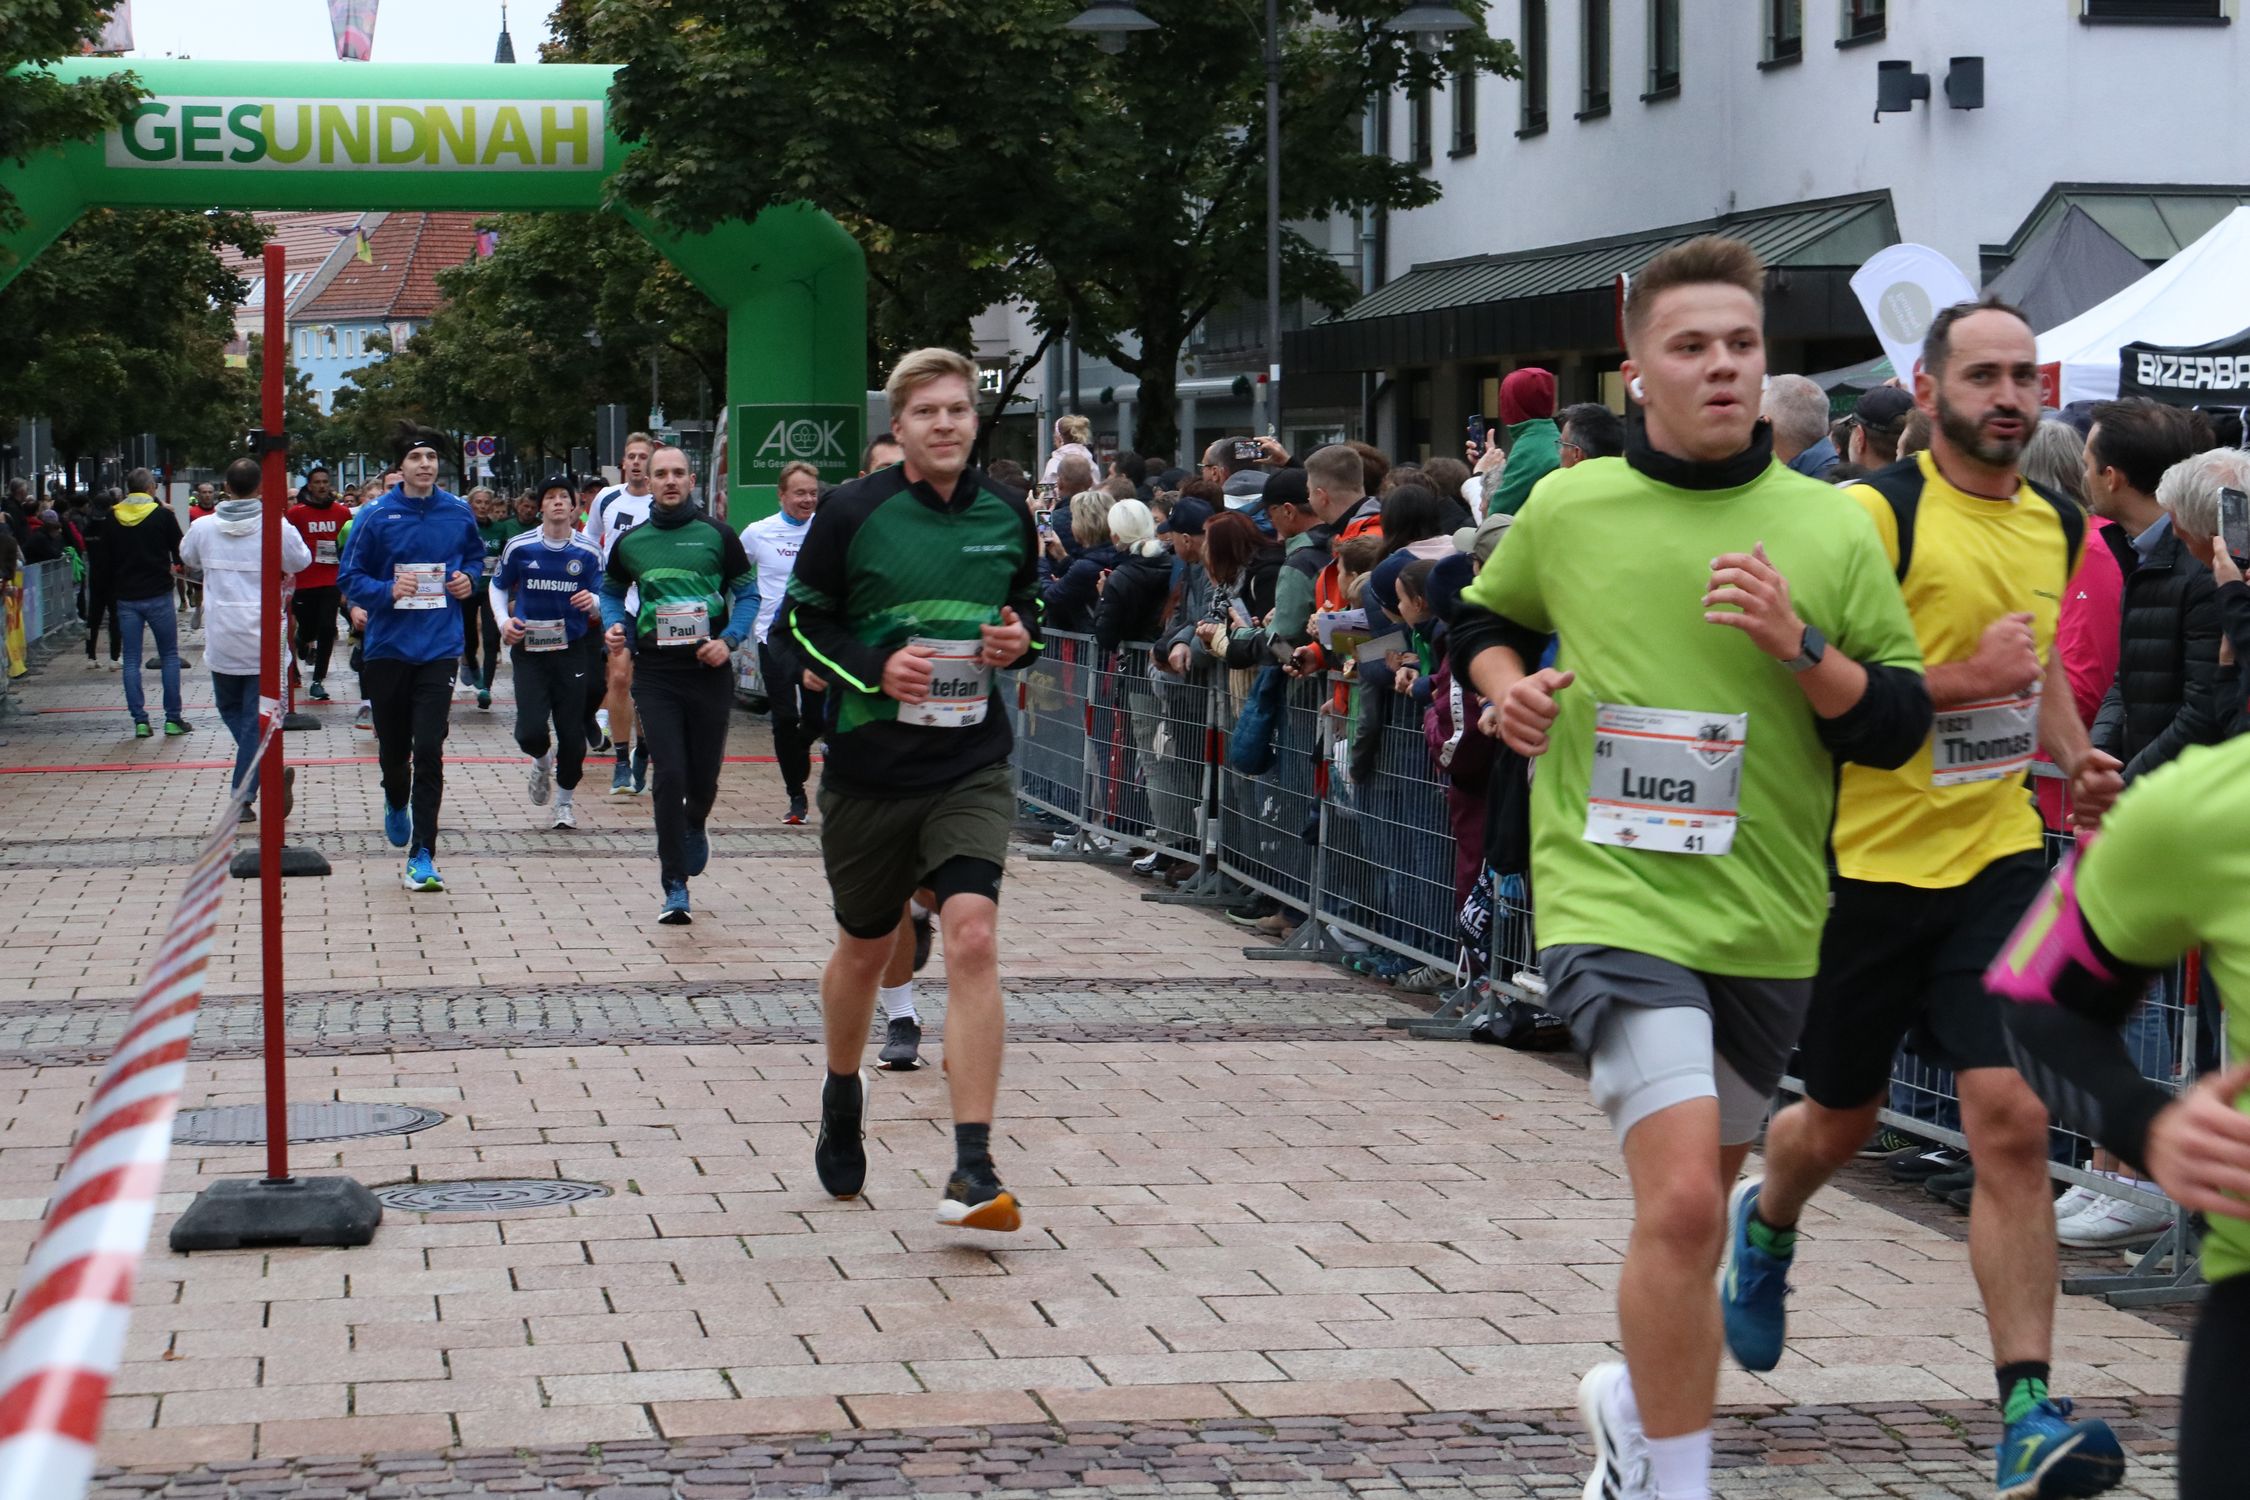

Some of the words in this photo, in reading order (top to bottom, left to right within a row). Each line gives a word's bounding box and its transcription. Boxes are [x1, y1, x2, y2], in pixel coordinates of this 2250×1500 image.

[122, 101, 588, 165] GESUNDNAH
[755, 419, 846, 457] AOK
[753, 459, 765, 468] Die
[308, 521, 336, 533] RAU
[526, 578, 578, 592] SAMSUNG
[670, 624, 696, 637] Paul
[528, 636, 562, 645] Hannes
[930, 677, 979, 696] tefan
[1595, 740, 1613, 758] 41
[1943, 732, 2031, 764] Thomas
[1622, 767, 1696, 803] Luca
[1683, 835, 1704, 851] 41
